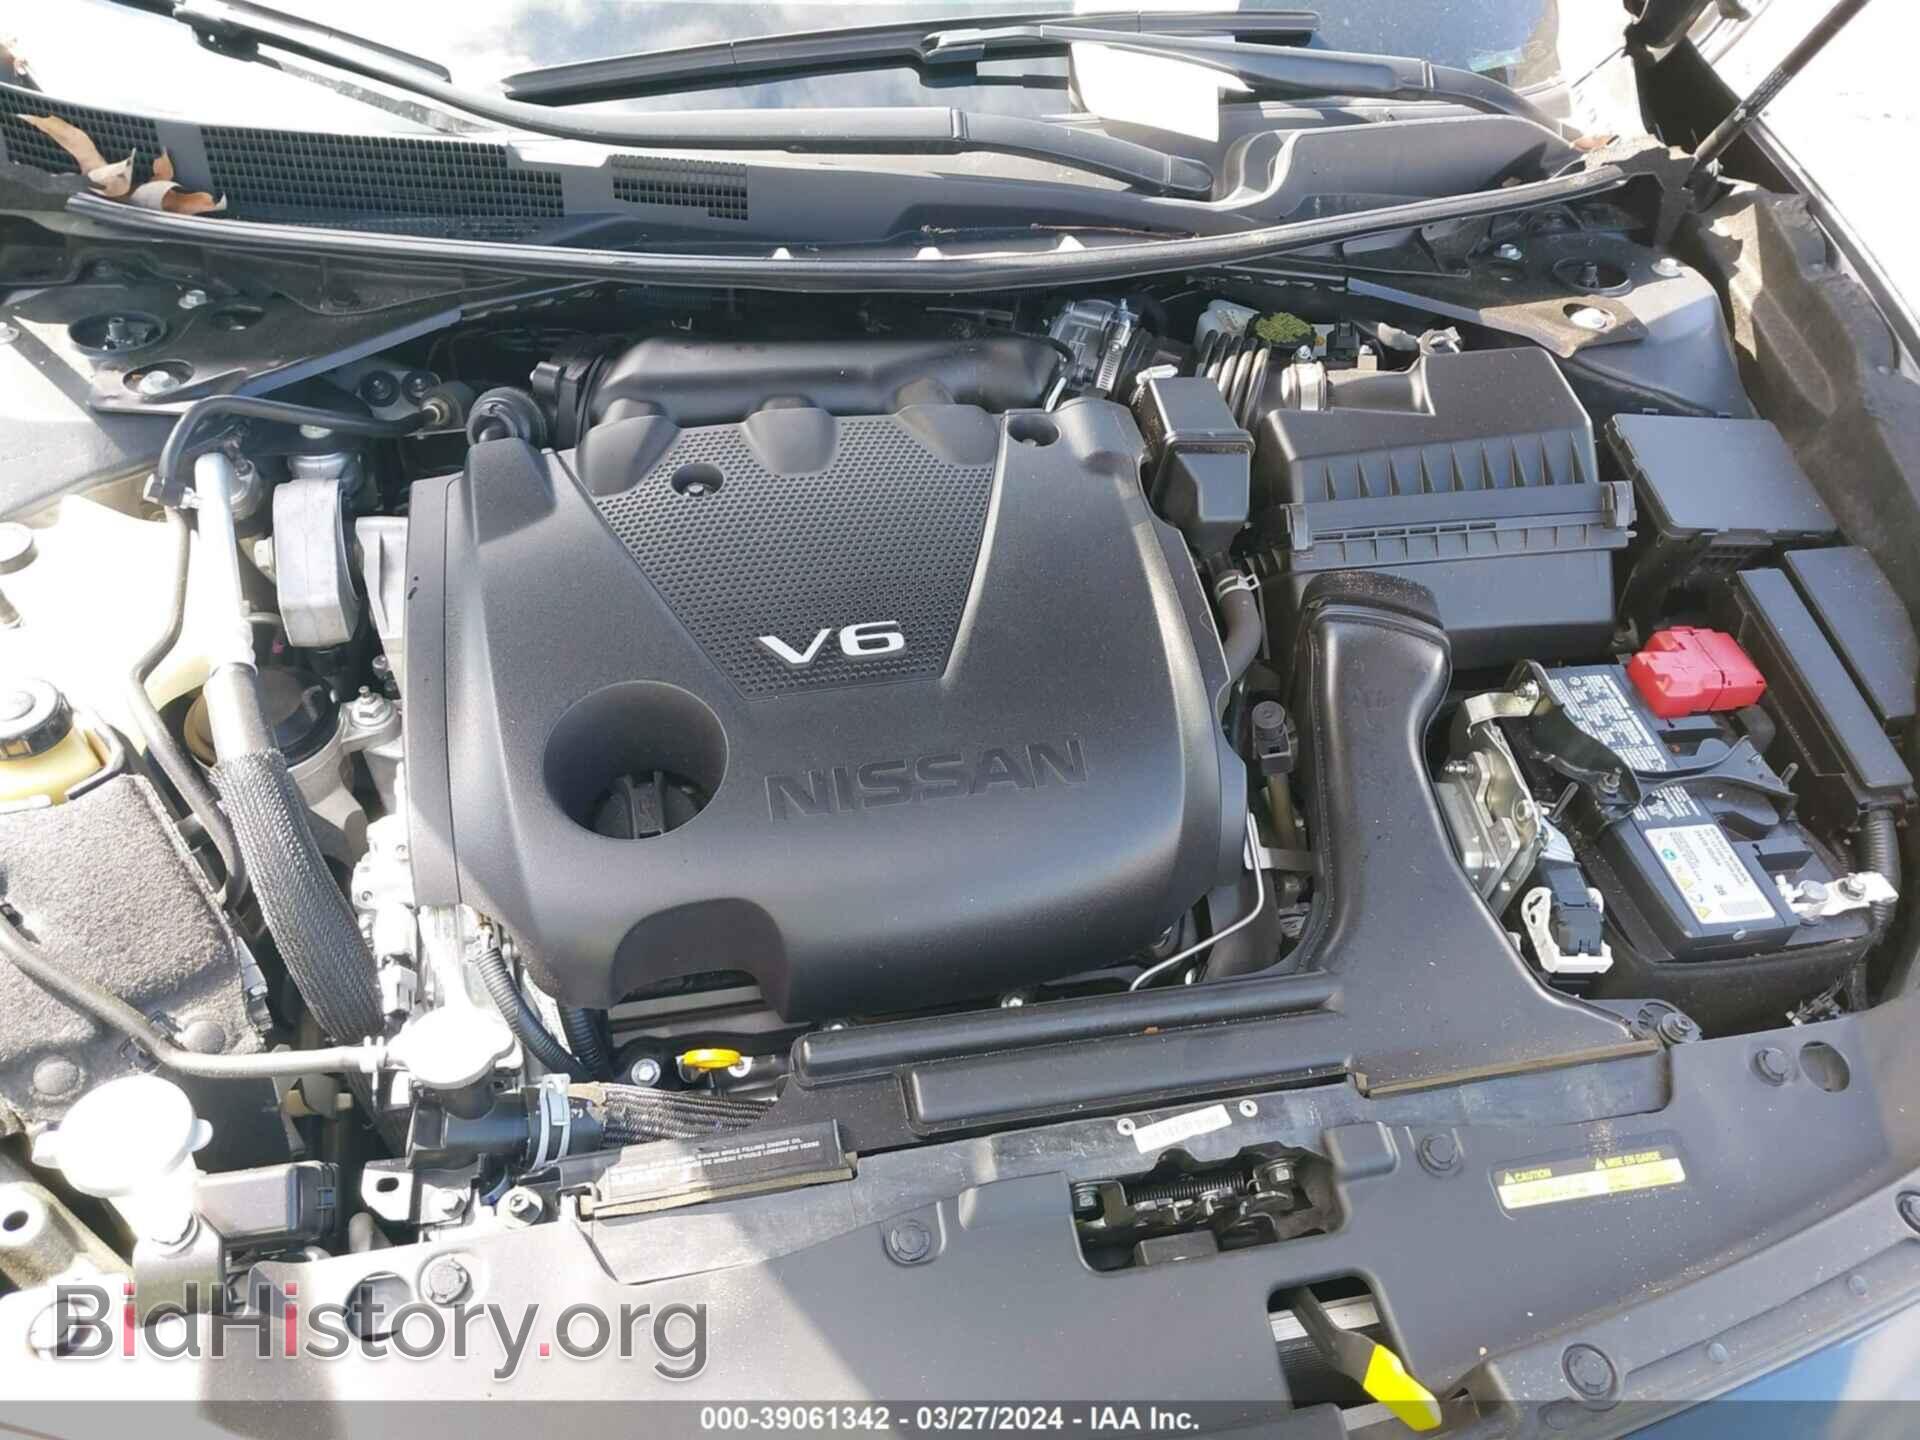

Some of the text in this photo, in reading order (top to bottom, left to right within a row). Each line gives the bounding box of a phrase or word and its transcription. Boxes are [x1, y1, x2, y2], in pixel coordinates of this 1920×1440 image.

[758, 620, 905, 665] V6
[764, 736, 1088, 823] NISSAN
[1514, 1167, 1552, 1184] CAUTION
